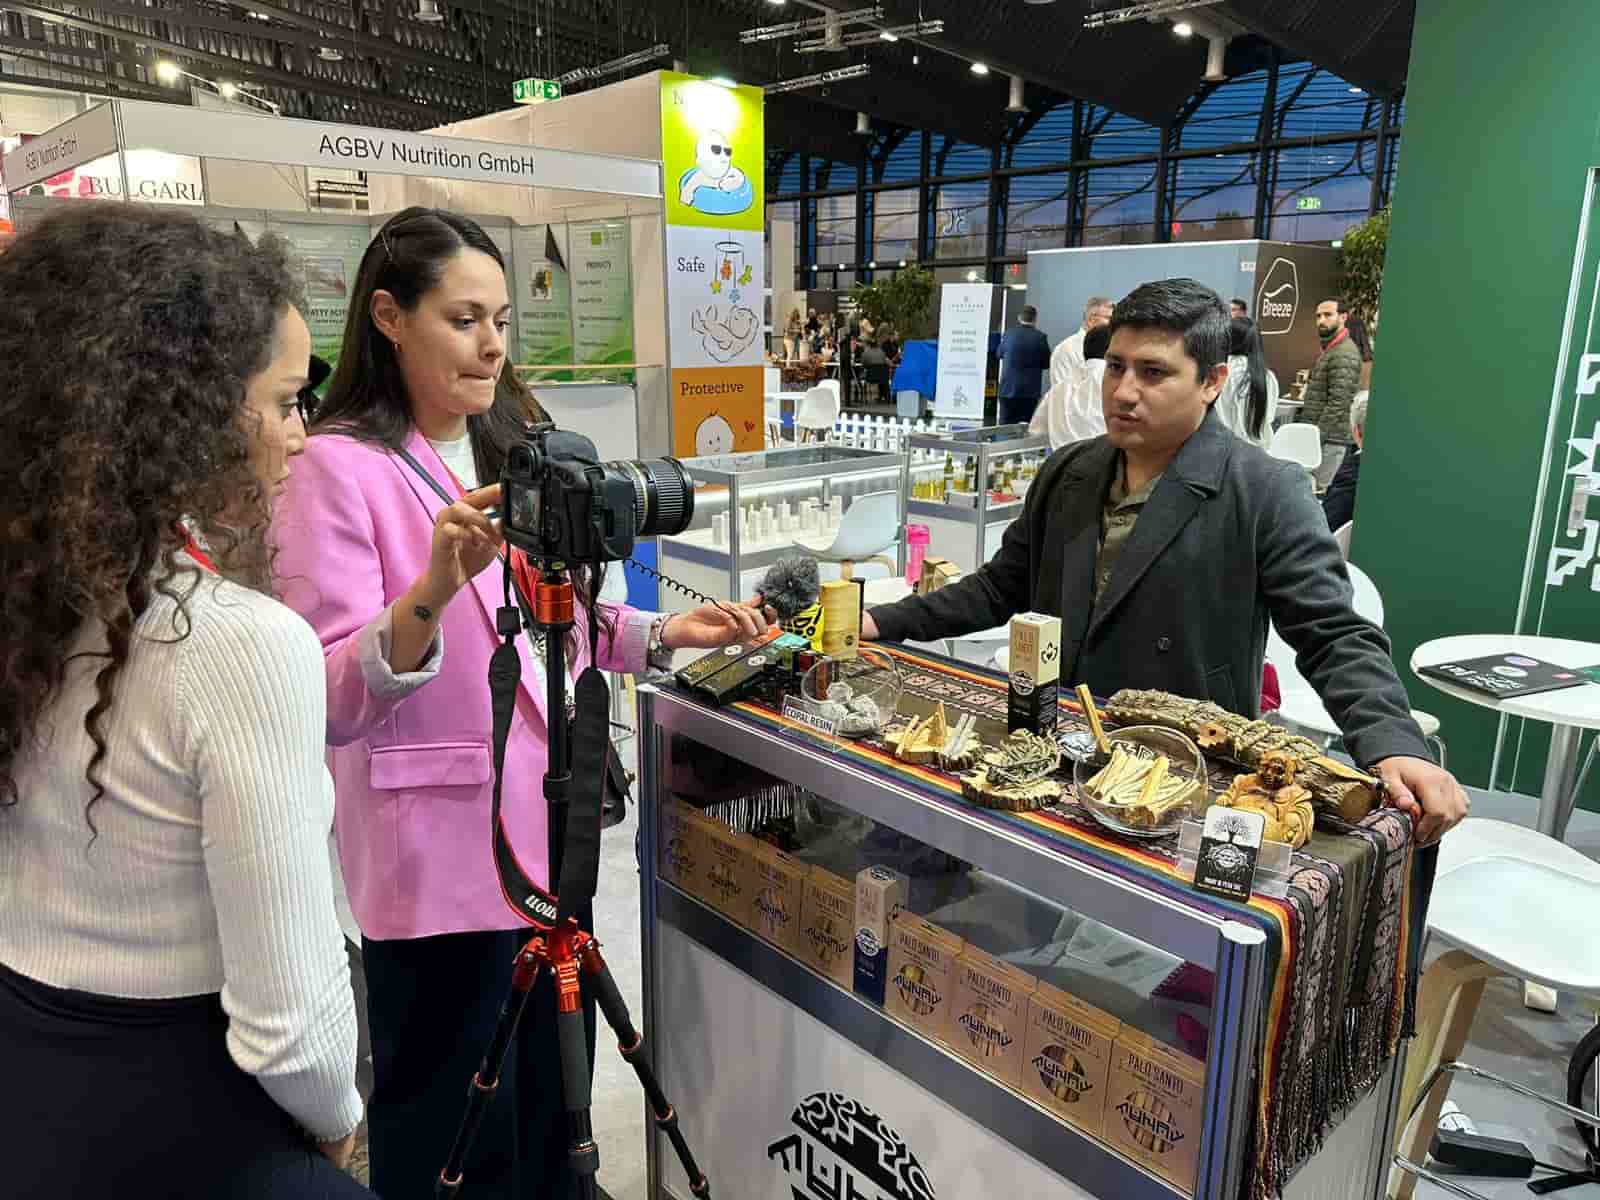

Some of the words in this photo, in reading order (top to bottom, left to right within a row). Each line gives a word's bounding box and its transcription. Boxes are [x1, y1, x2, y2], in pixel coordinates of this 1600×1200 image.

[318, 133, 384, 160] AGBV
[391, 141, 472, 170] Nutrition
[478, 152, 535, 176] GmbH
[676, 256, 706, 274] Safe
[1262, 298, 1293, 319] Breeze
[679, 380, 745, 397] Protective
[786, 706, 810, 725] COPAL
[809, 715, 833, 732] RESIN
[1042, 1009, 1065, 1033] PALO
[1063, 1021, 1091, 1046] SANTO
[1128, 1053, 1153, 1079] PALO
[1151, 1066, 1185, 1096] SANTO
